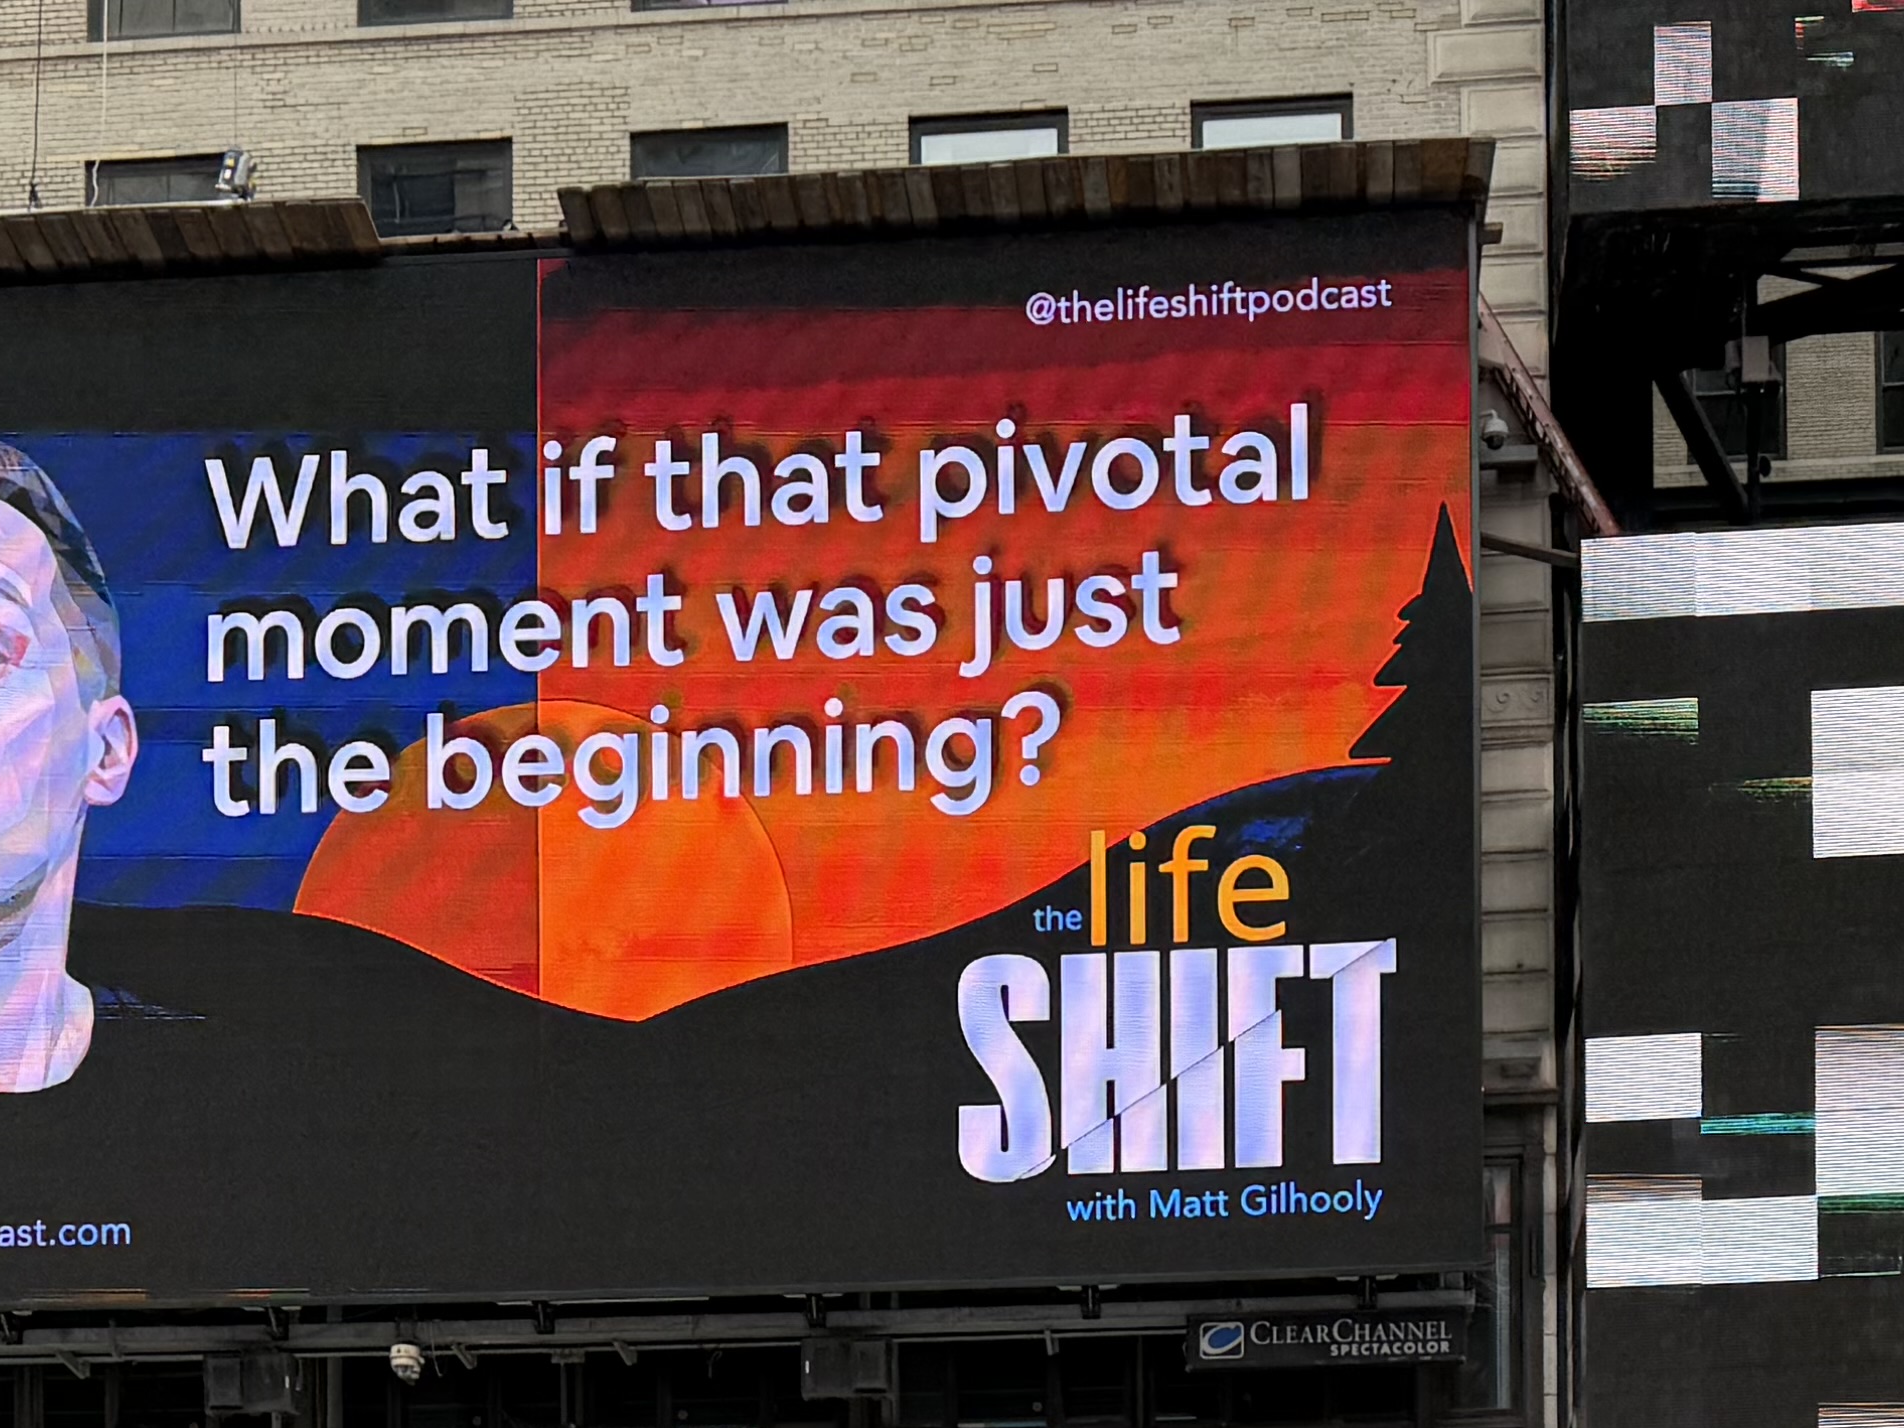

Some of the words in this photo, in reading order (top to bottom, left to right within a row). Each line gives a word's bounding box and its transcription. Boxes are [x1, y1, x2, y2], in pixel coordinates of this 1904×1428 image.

[1025, 278, 1392, 326] @thelifeshiftpodcast
[204, 449, 509, 550] What
[543, 435, 616, 535] if
[643, 429, 884, 531] that
[918, 402, 1310, 543] pivotal
[207, 574, 685, 683] moment
[716, 581, 942, 662] was
[959, 550, 1180, 678] just
[201, 713, 392, 818] the
[427, 690, 1064, 830] beginning?
[1033, 904, 1084, 933] the
[1090, 825, 1290, 946] life
[957, 937, 1397, 1183] SHIFT
[1067, 1190, 1136, 1222] with
[1149, 1187, 1229, 1219] Matt
[1239, 1179, 1383, 1220] Gilhooly
[1329, 1340, 1451, 1356] SPECTACOLOR
